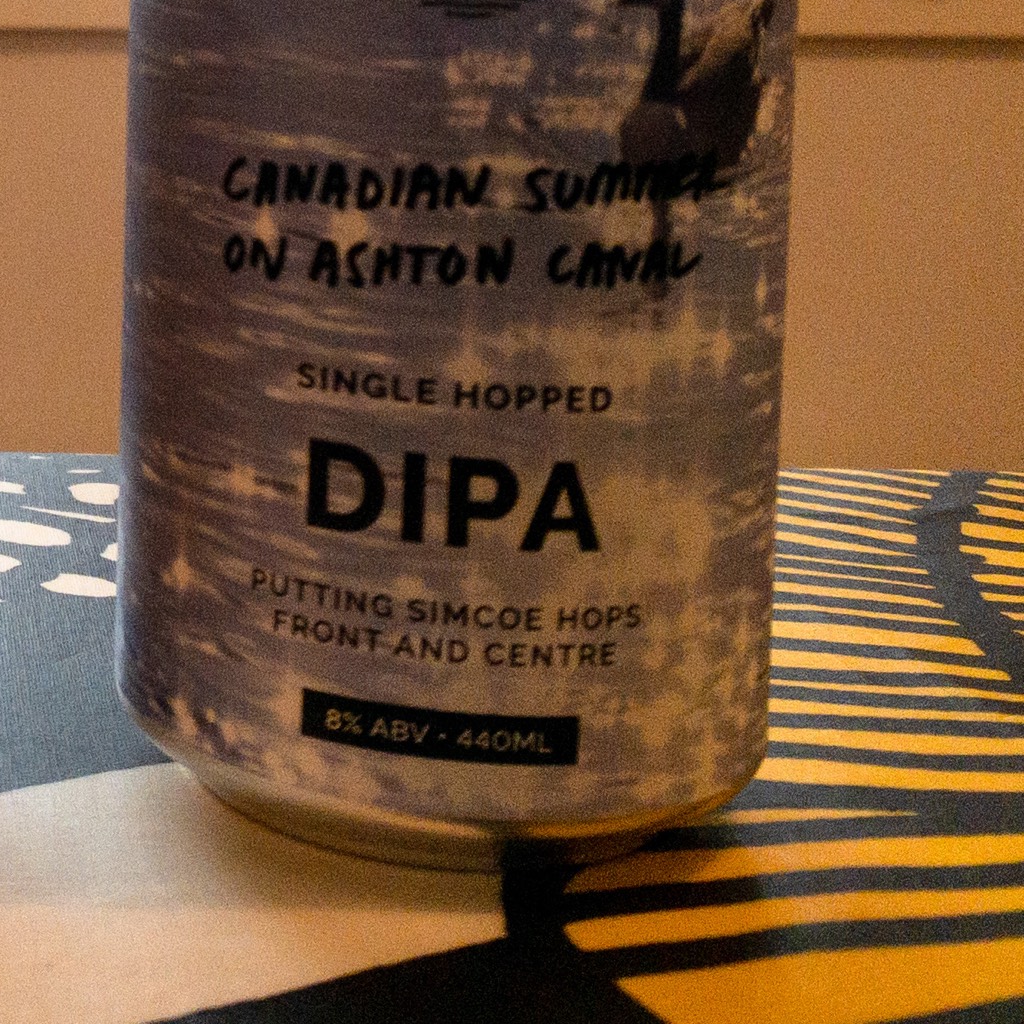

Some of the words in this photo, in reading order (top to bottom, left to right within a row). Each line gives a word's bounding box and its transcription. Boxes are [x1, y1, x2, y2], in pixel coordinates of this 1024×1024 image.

[222, 155, 492, 213] CANADIAN
[223, 233, 287, 281] ON
[310, 236, 515, 289] ASHTON
[549, 238, 703, 289] CANAL
[296, 362, 439, 405] SINGLE
[453, 380, 614, 414] HOPPED
[305, 436, 601, 553] DIPA
[251, 569, 394, 619] PUTTING
[407, 597, 545, 633] SIMCOE
[556, 603, 643, 632] HOPS
[272, 608, 382, 649] FRONT
[392, 634, 470, 664] AND
[483, 641, 618, 669] CENTRE
[324, 707, 362, 734] 8%
[370, 718, 430, 744] ABV
[456, 728, 553, 755] 440ML
